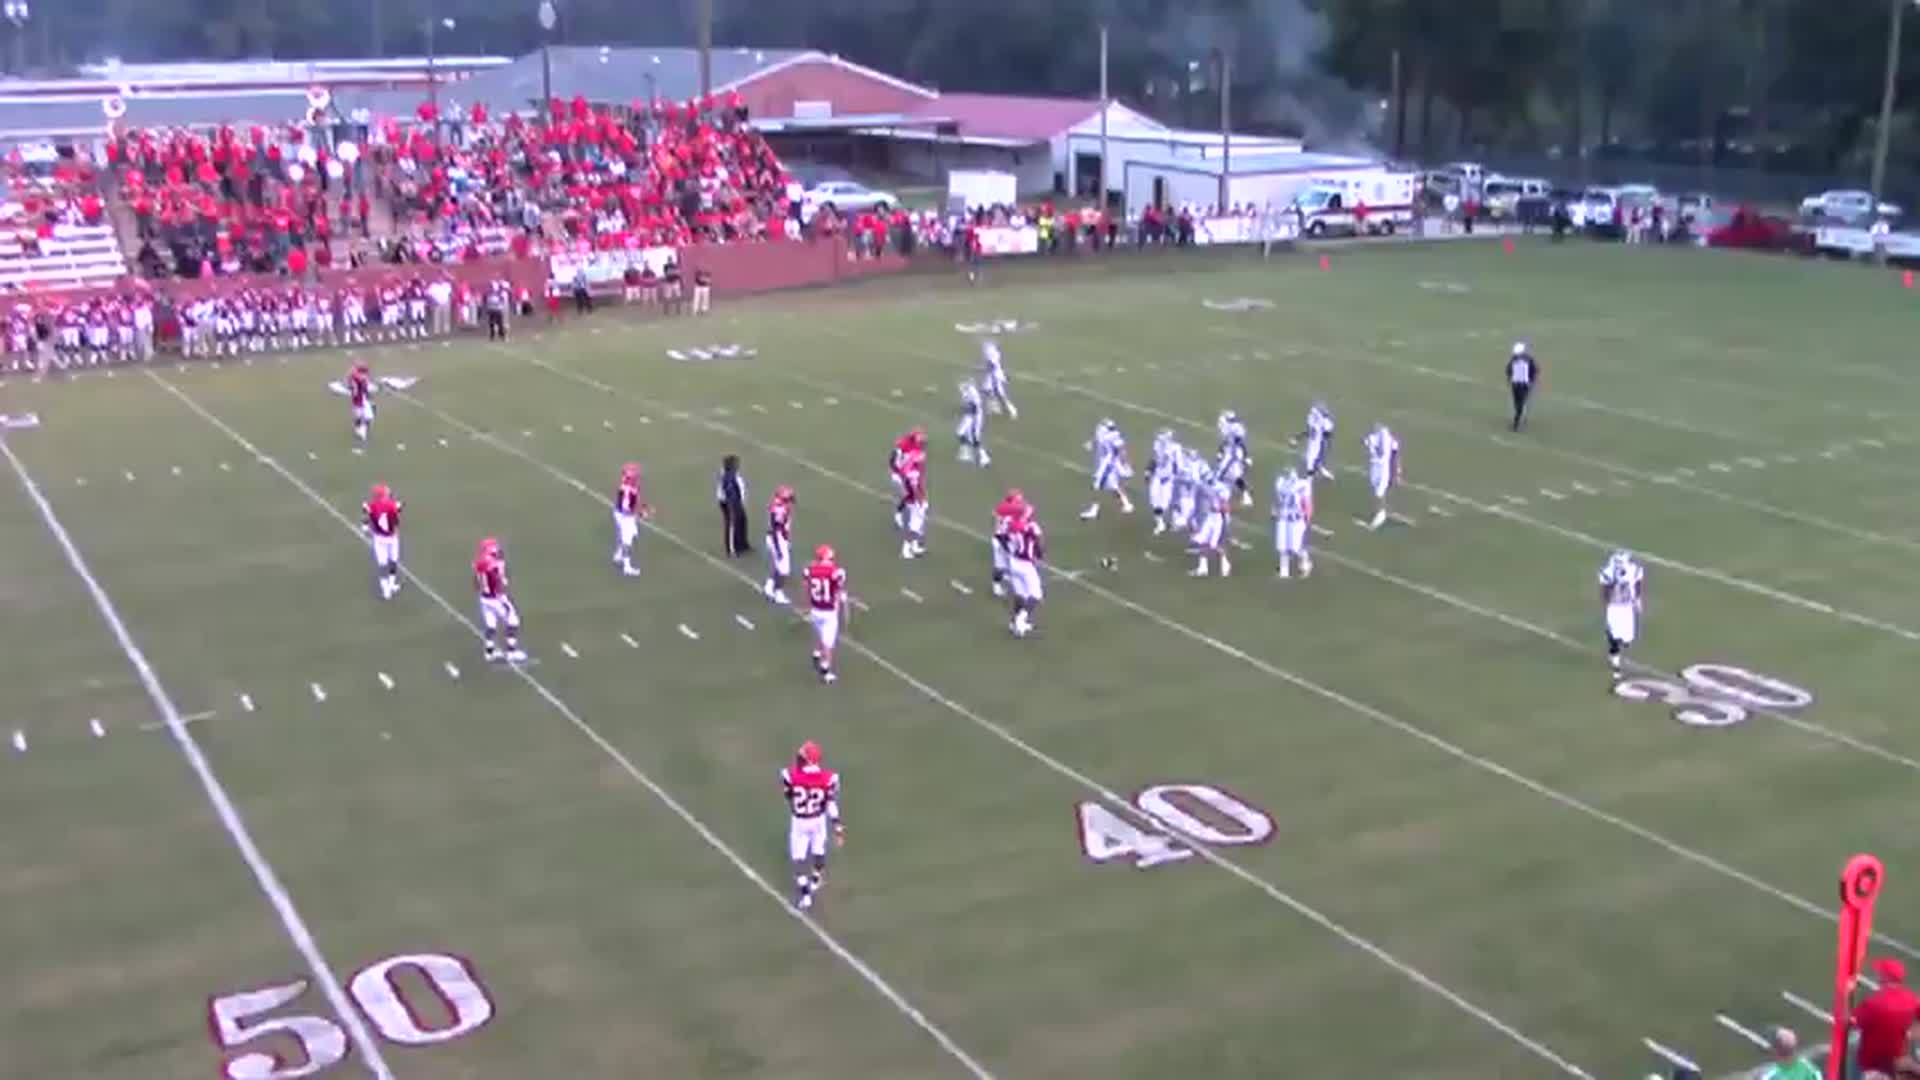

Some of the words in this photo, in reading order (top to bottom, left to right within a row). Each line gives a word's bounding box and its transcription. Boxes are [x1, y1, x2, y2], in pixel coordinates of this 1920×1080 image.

[810, 577, 831, 602] 21
[1612, 663, 1814, 725] 30
[792, 785, 825, 814] 22
[1077, 784, 1275, 868] 40
[208, 953, 493, 1080] 50
